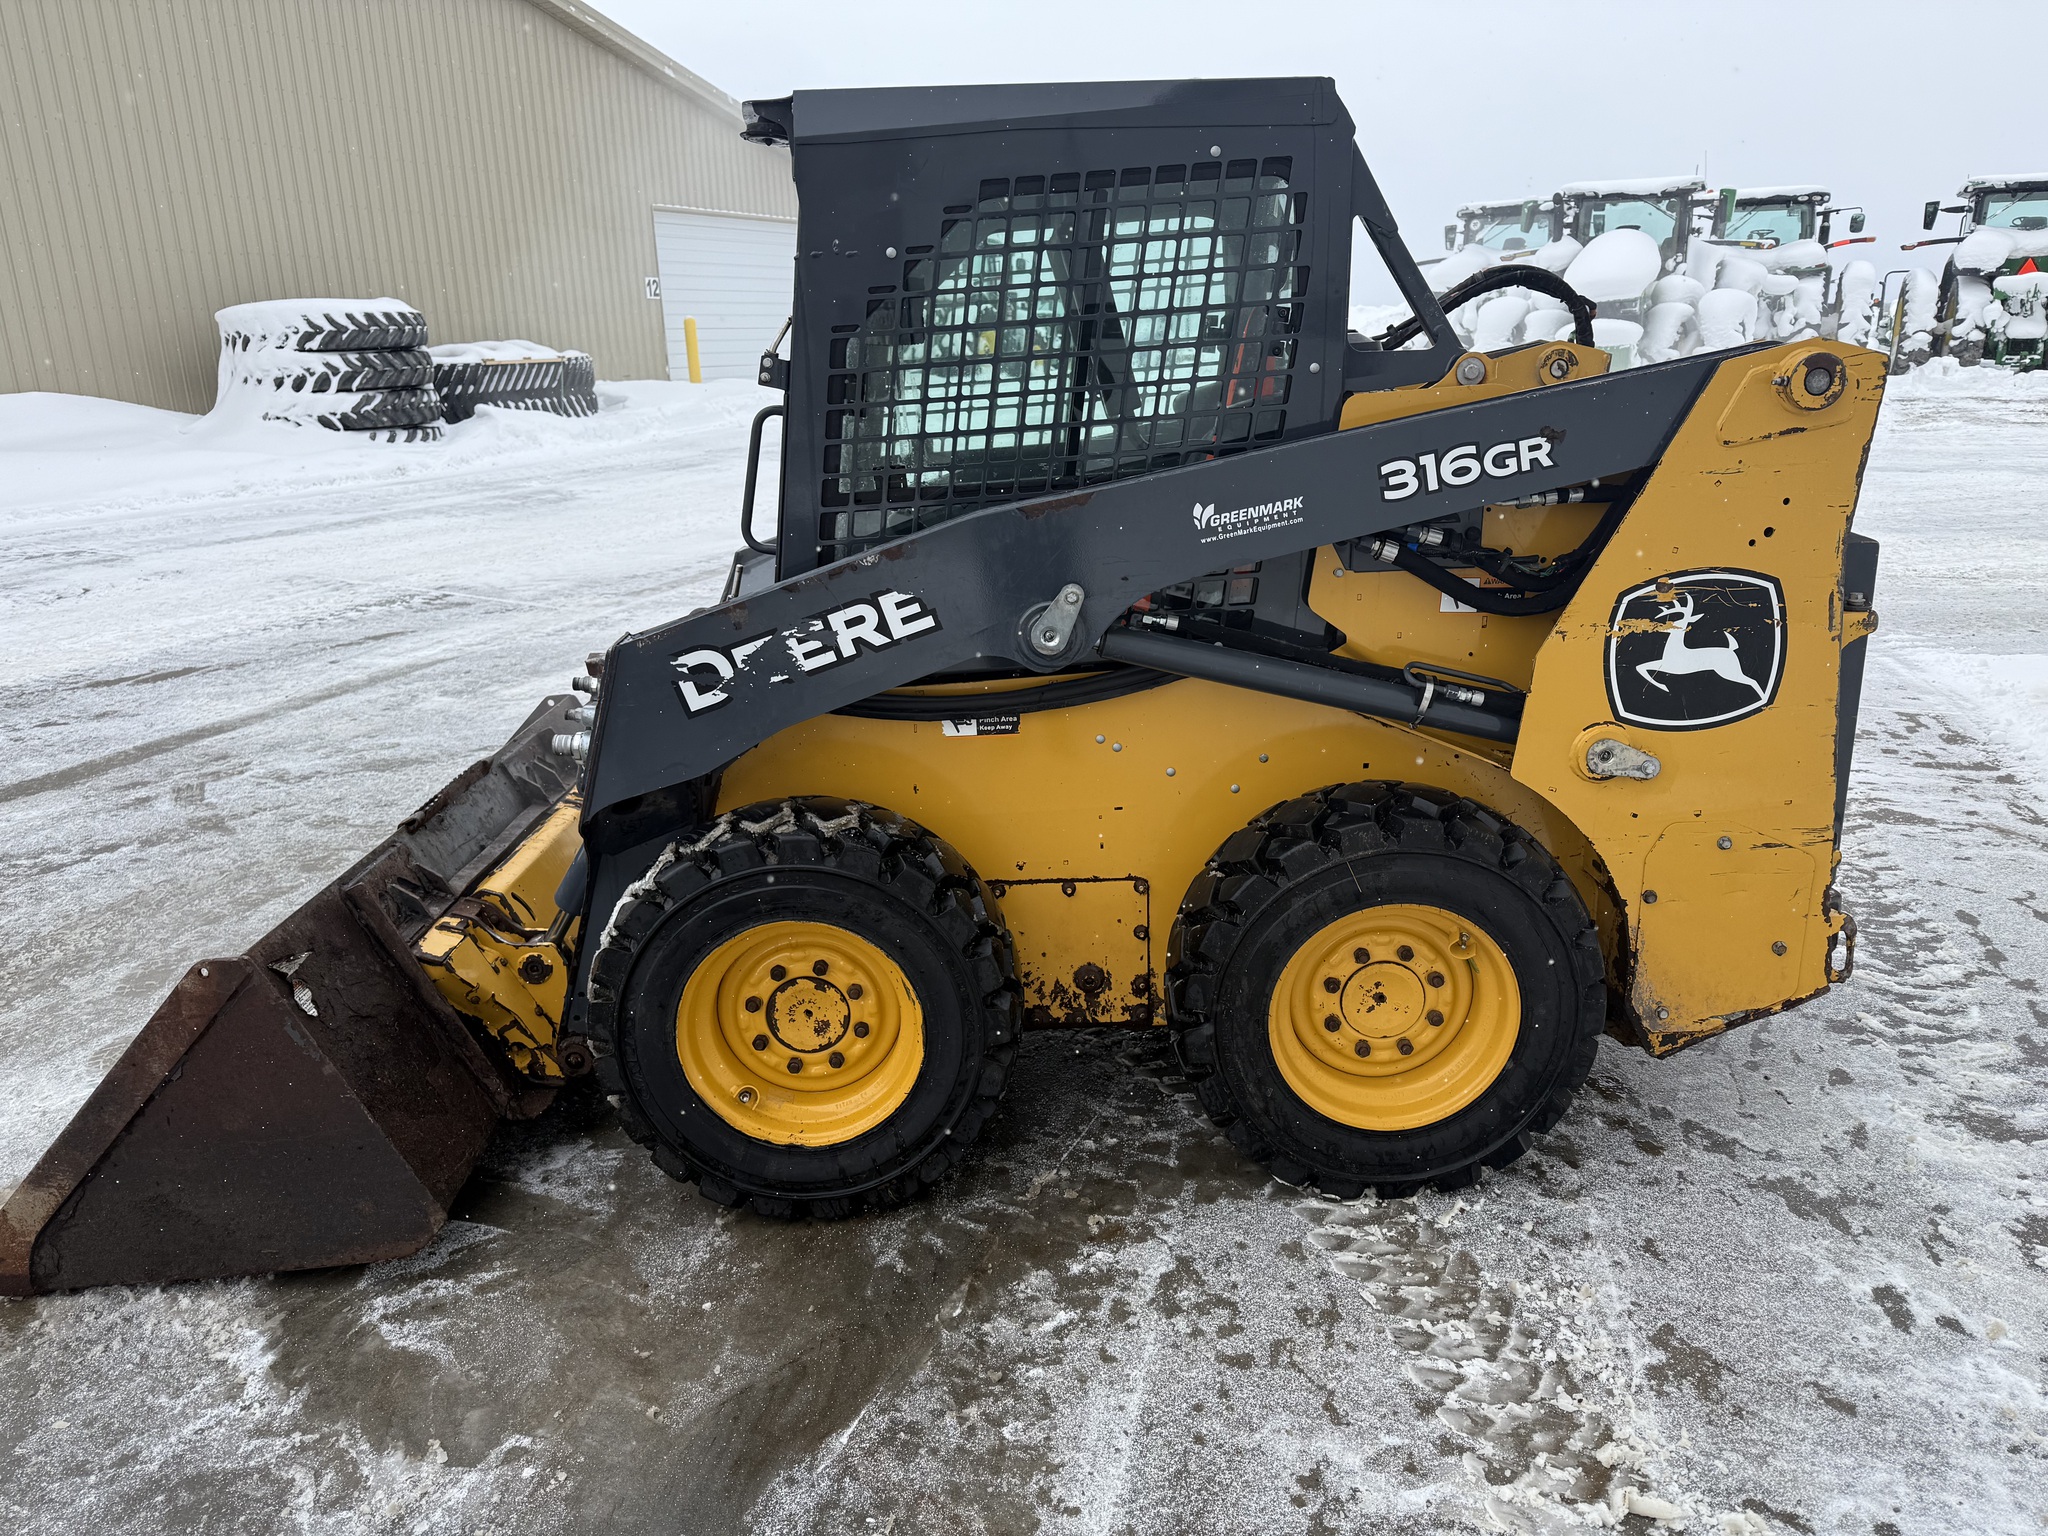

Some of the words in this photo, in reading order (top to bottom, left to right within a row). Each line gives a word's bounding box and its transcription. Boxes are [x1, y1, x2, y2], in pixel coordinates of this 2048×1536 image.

[647, 279, 660, 297] 12
[1380, 437, 1554, 500] 316GR
[1210, 496, 1303, 527] GREENMARK
[1218, 511, 1297, 532] EQUIPMENT
[1200, 516, 1304, 544] www.GreenMarkEquipment.com
